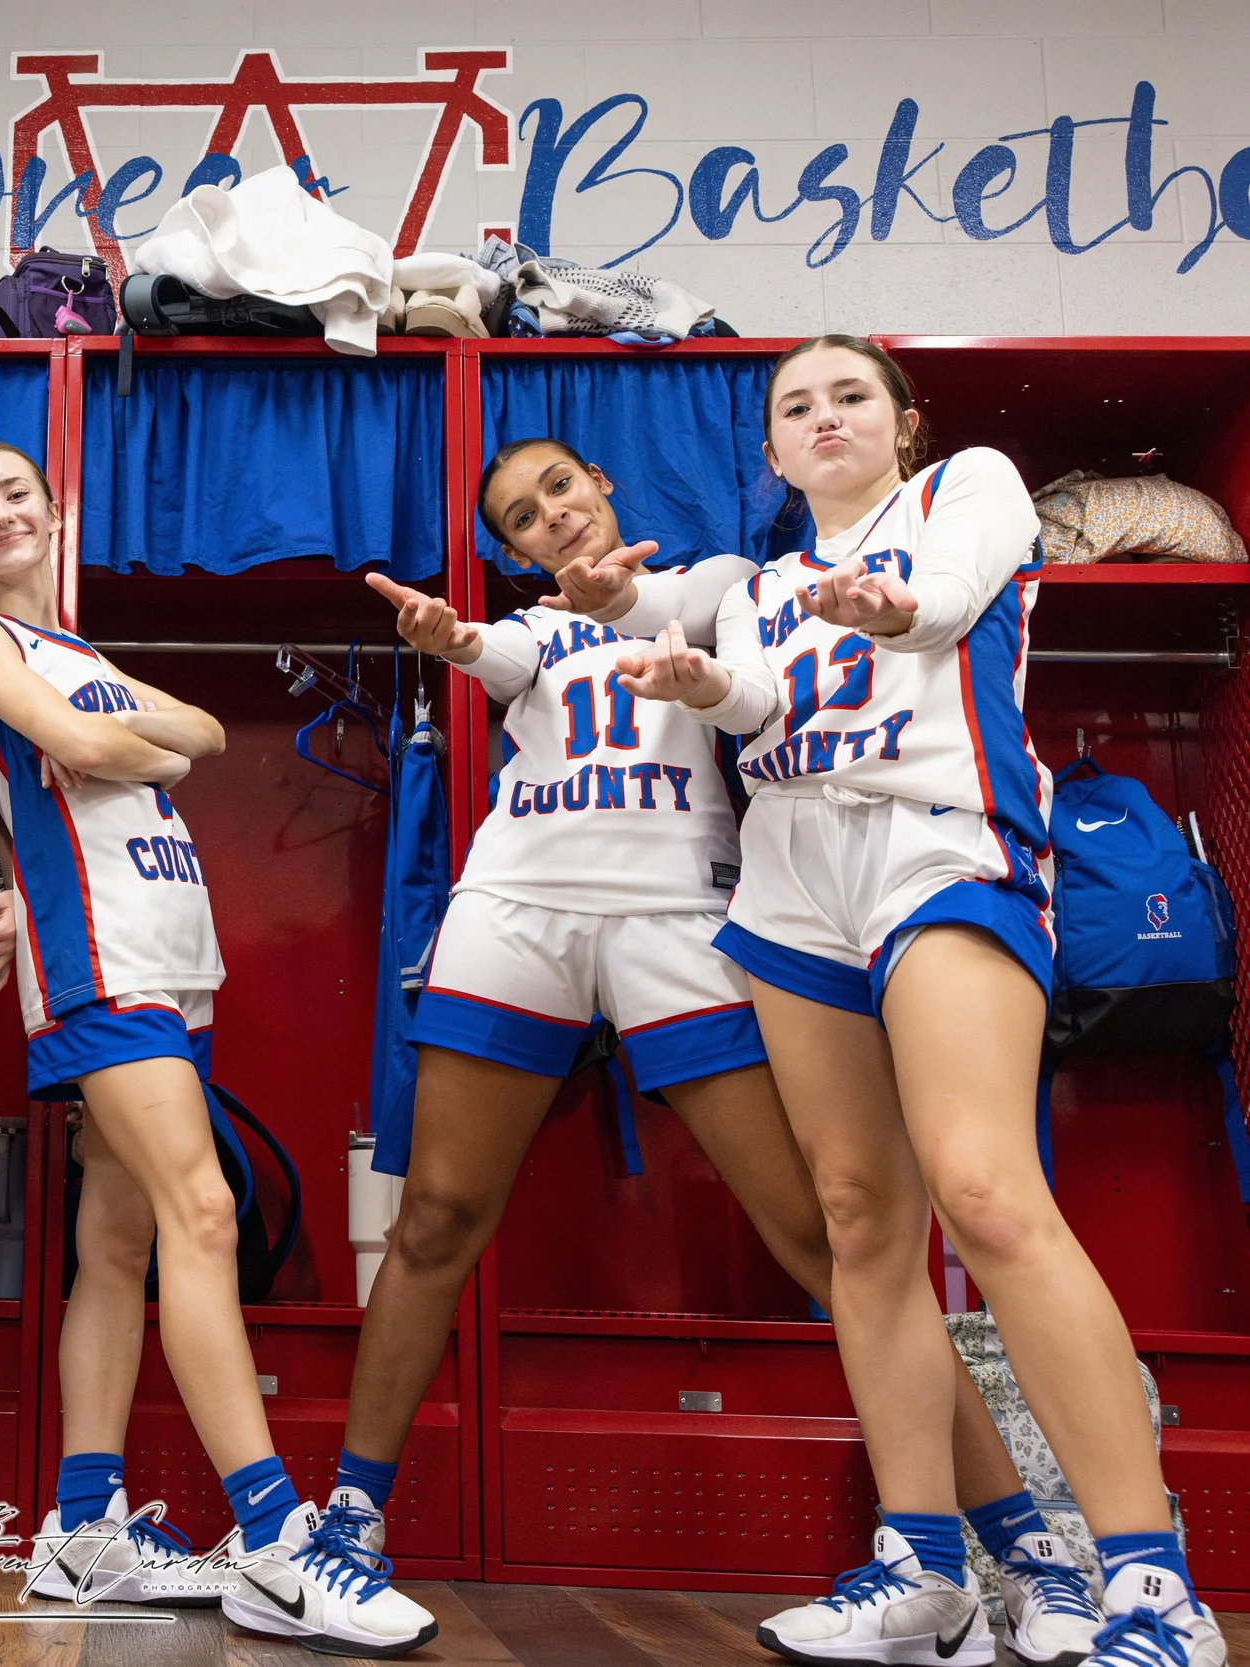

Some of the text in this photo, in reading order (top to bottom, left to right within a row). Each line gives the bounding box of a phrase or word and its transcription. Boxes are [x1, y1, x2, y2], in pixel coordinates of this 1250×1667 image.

[561, 669, 640, 760] 11
[783, 632, 876, 743] 13
[510, 762, 693, 818] COUNTY
[1137, 931, 1183, 941] BASKETBALL
